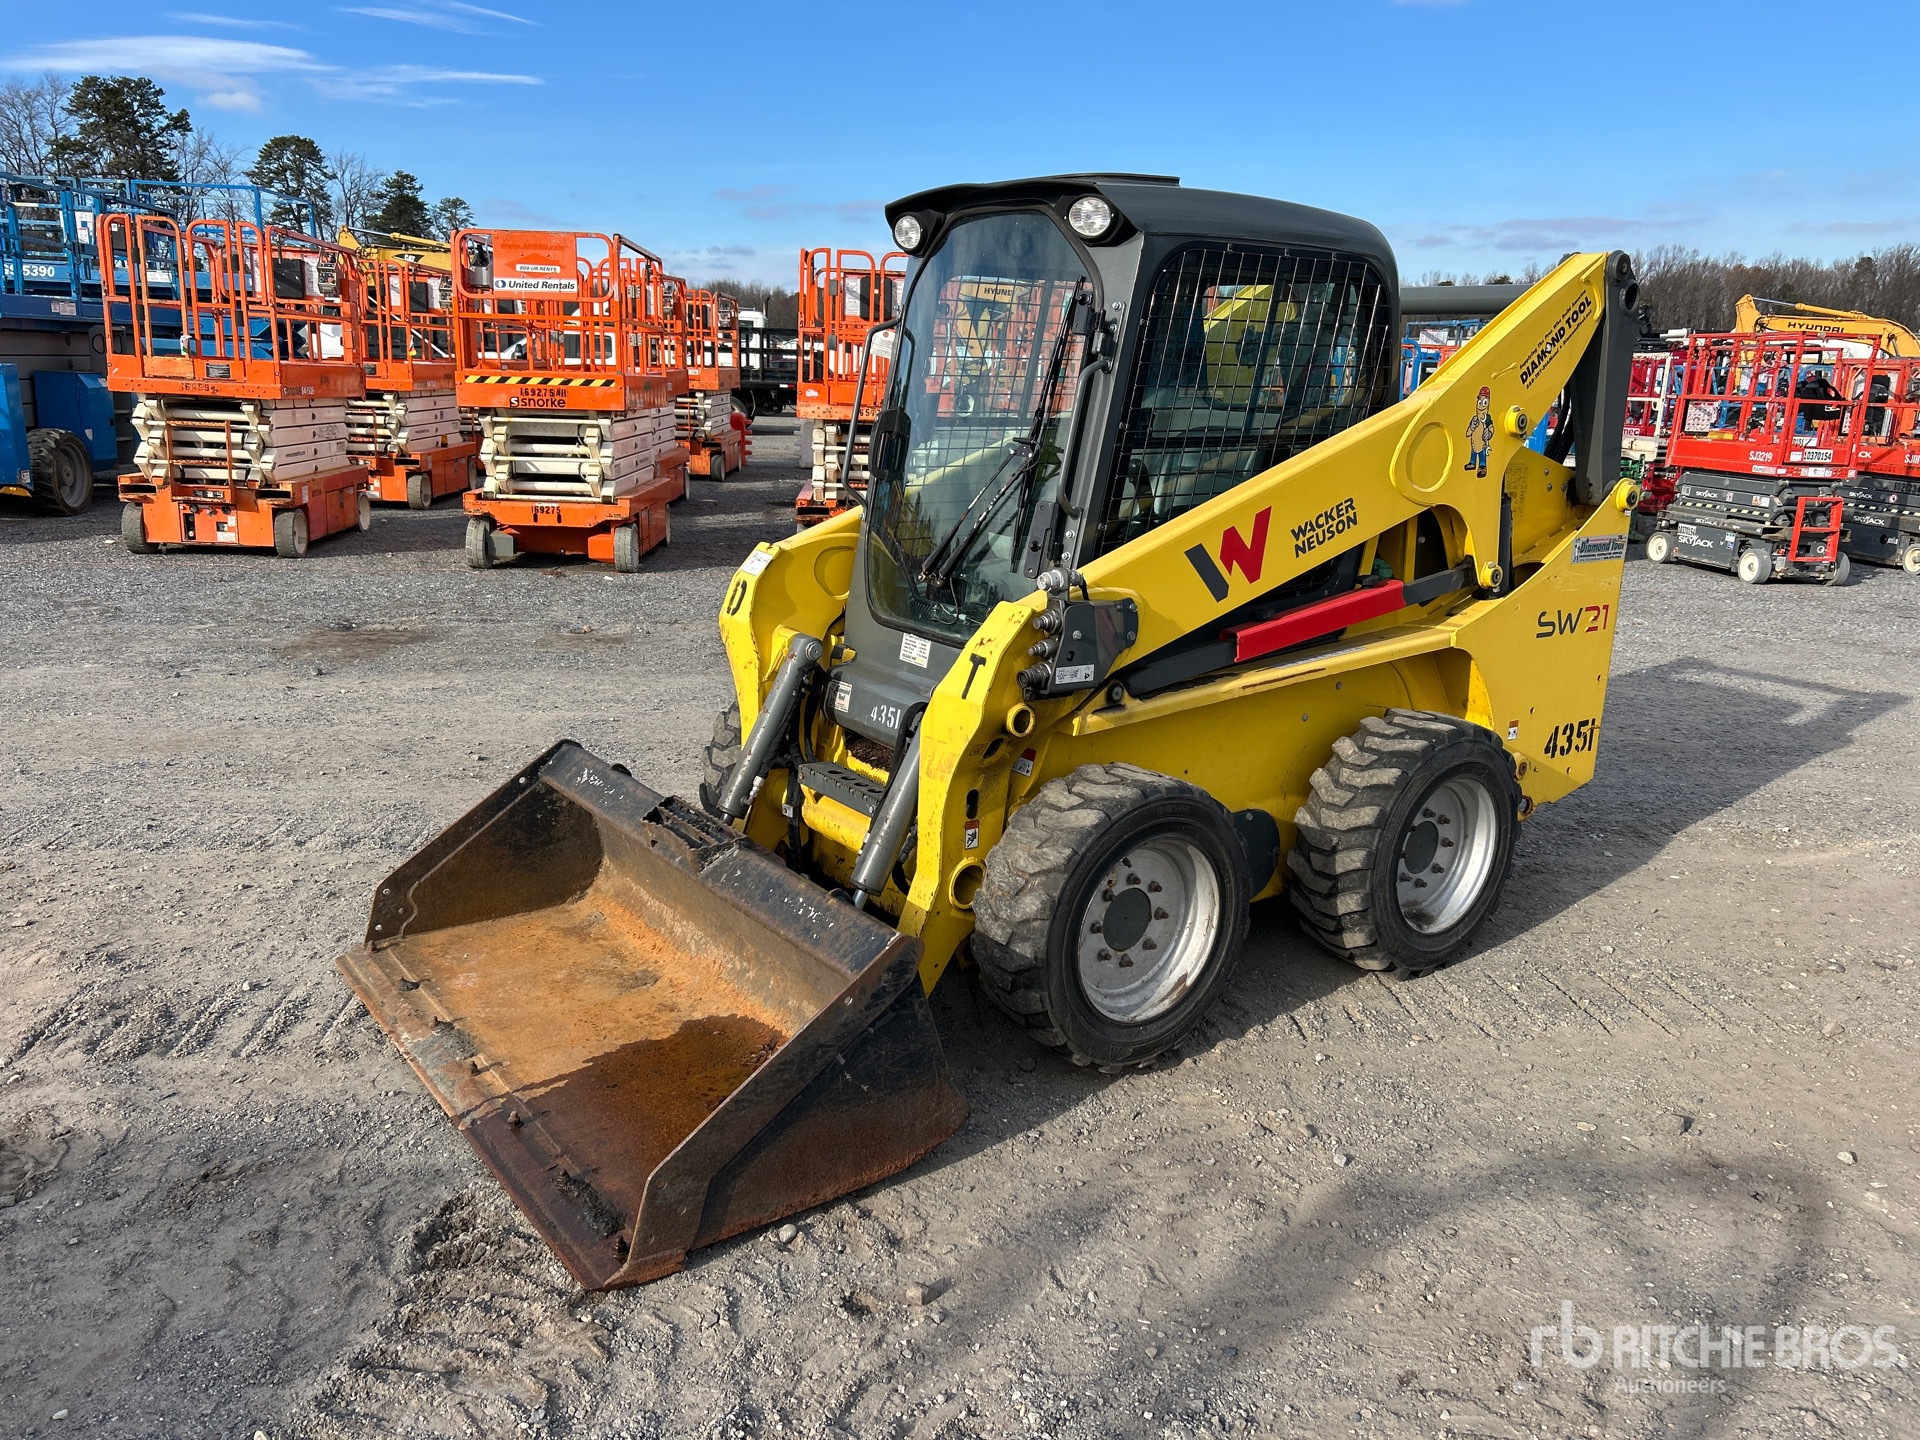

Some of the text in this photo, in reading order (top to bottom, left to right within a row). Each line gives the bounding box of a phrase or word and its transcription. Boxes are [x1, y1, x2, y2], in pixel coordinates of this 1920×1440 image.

[508, 281, 575, 290] United Rentals
[1787, 321, 1845, 333] HYUNDAI
[1520, 296, 1592, 385] DIAMOND TOOL
[1748, 450, 1773, 463] SJ3219
[1803, 450, 1832, 462] 10370154
[1695, 490, 1718, 498] SKYJACK
[1849, 491, 1873, 499] SKYJACK
[531, 505, 561, 514] 169275
[1290, 497, 1356, 542] WACKER
[1853, 515, 1885, 526] SKYJACK
[1294, 511, 1358, 558] NEUSON
[1677, 534, 1714, 549] SKYJACK
[1535, 604, 1610, 639] SW21
[870, 704, 901, 730] 4351
[1543, 718, 1596, 759] 4351
